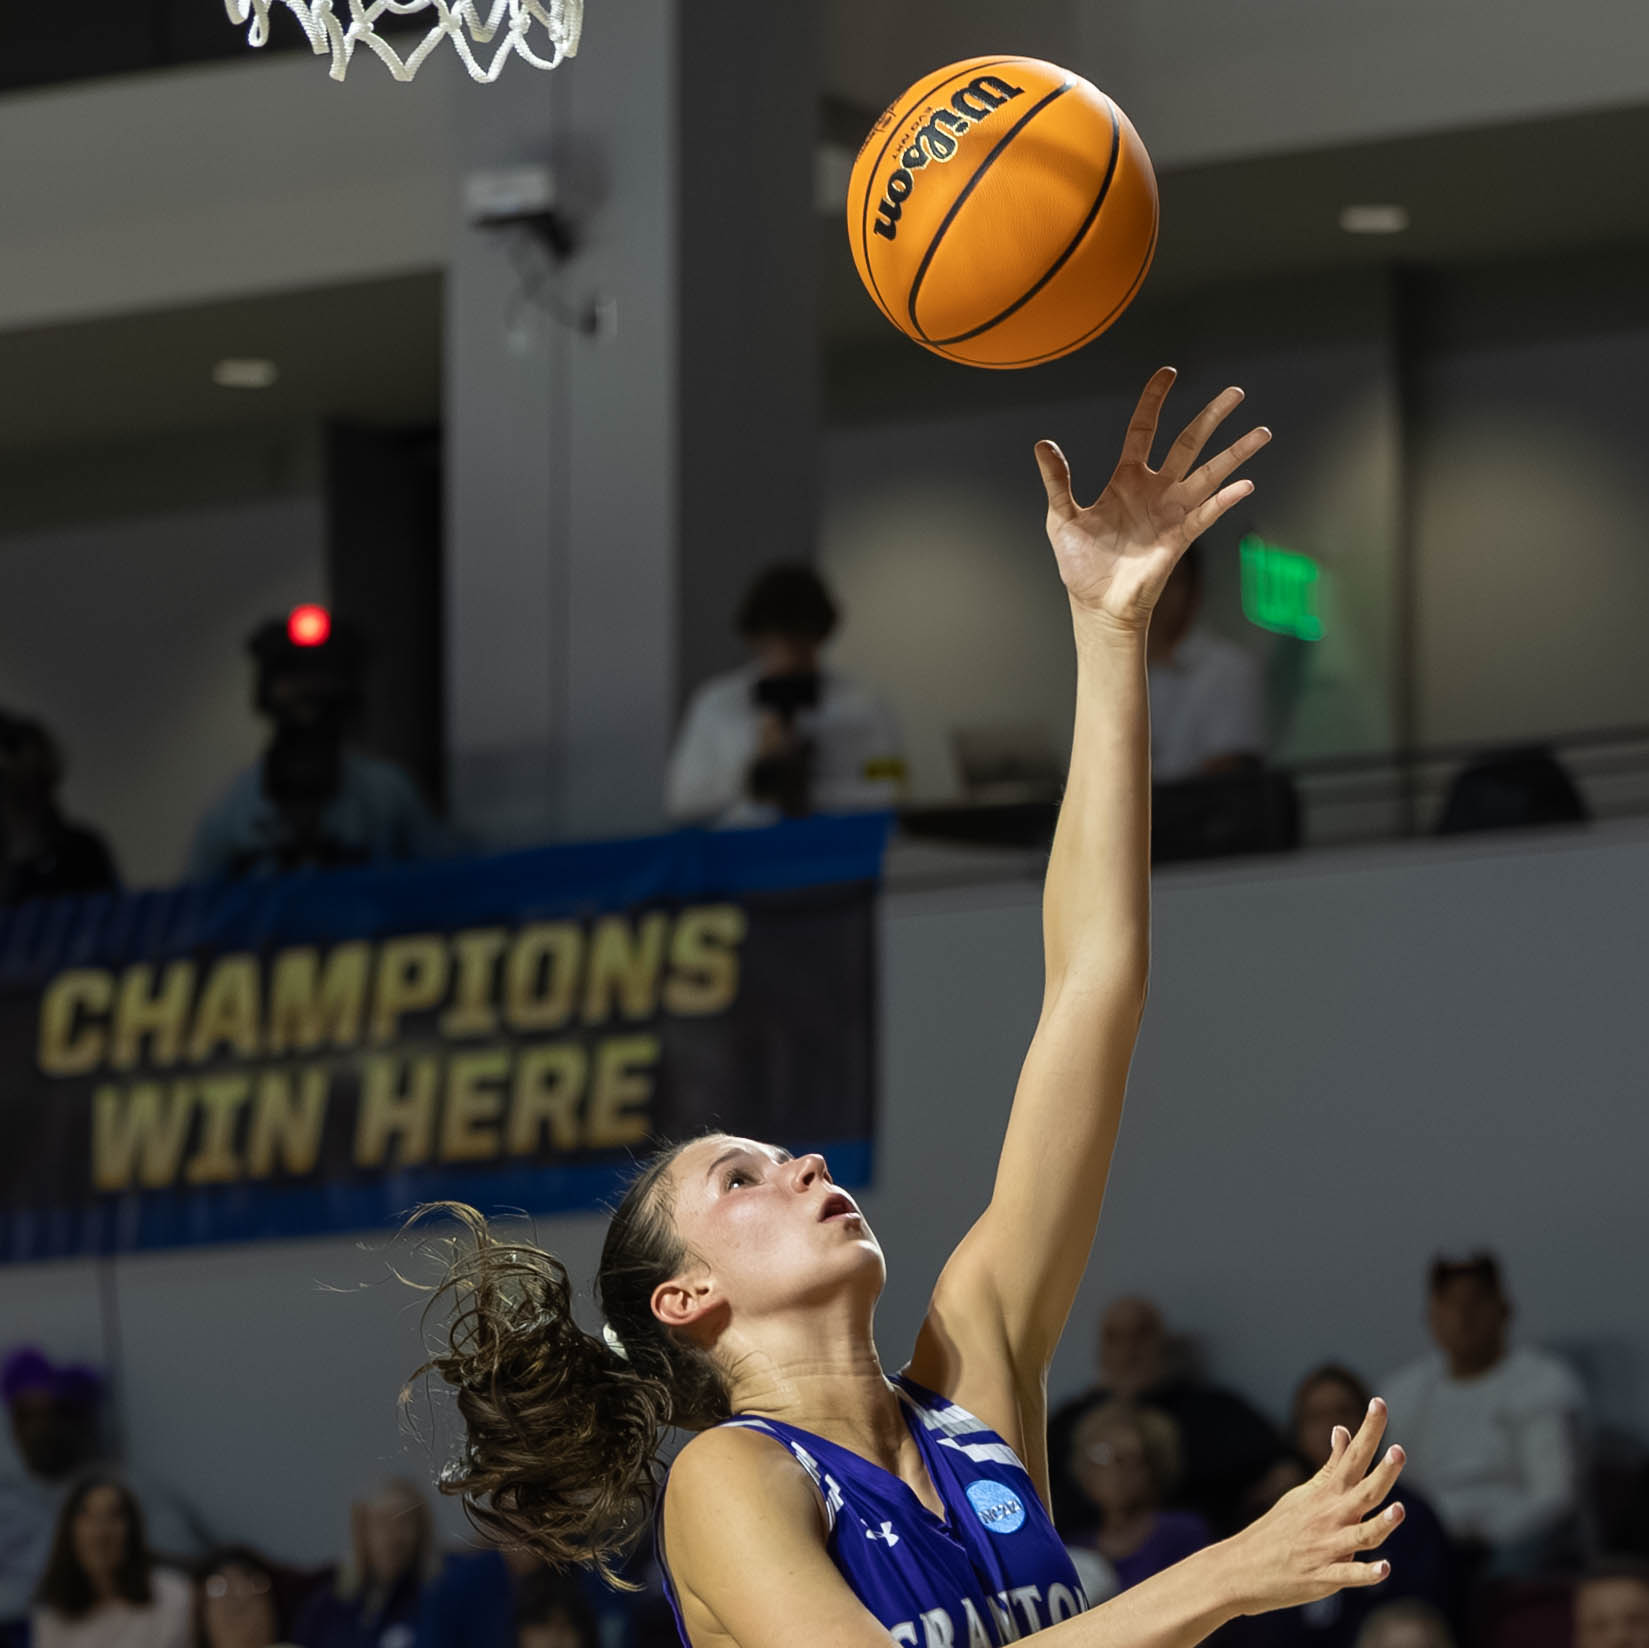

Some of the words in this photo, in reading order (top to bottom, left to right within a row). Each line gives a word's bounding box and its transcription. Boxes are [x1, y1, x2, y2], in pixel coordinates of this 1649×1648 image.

[873, 75, 1025, 241] Wilson
[38, 905, 746, 1077] CHAMPIONS
[93, 1070, 332, 1190] WIN
[352, 1034, 661, 1168] HERE
